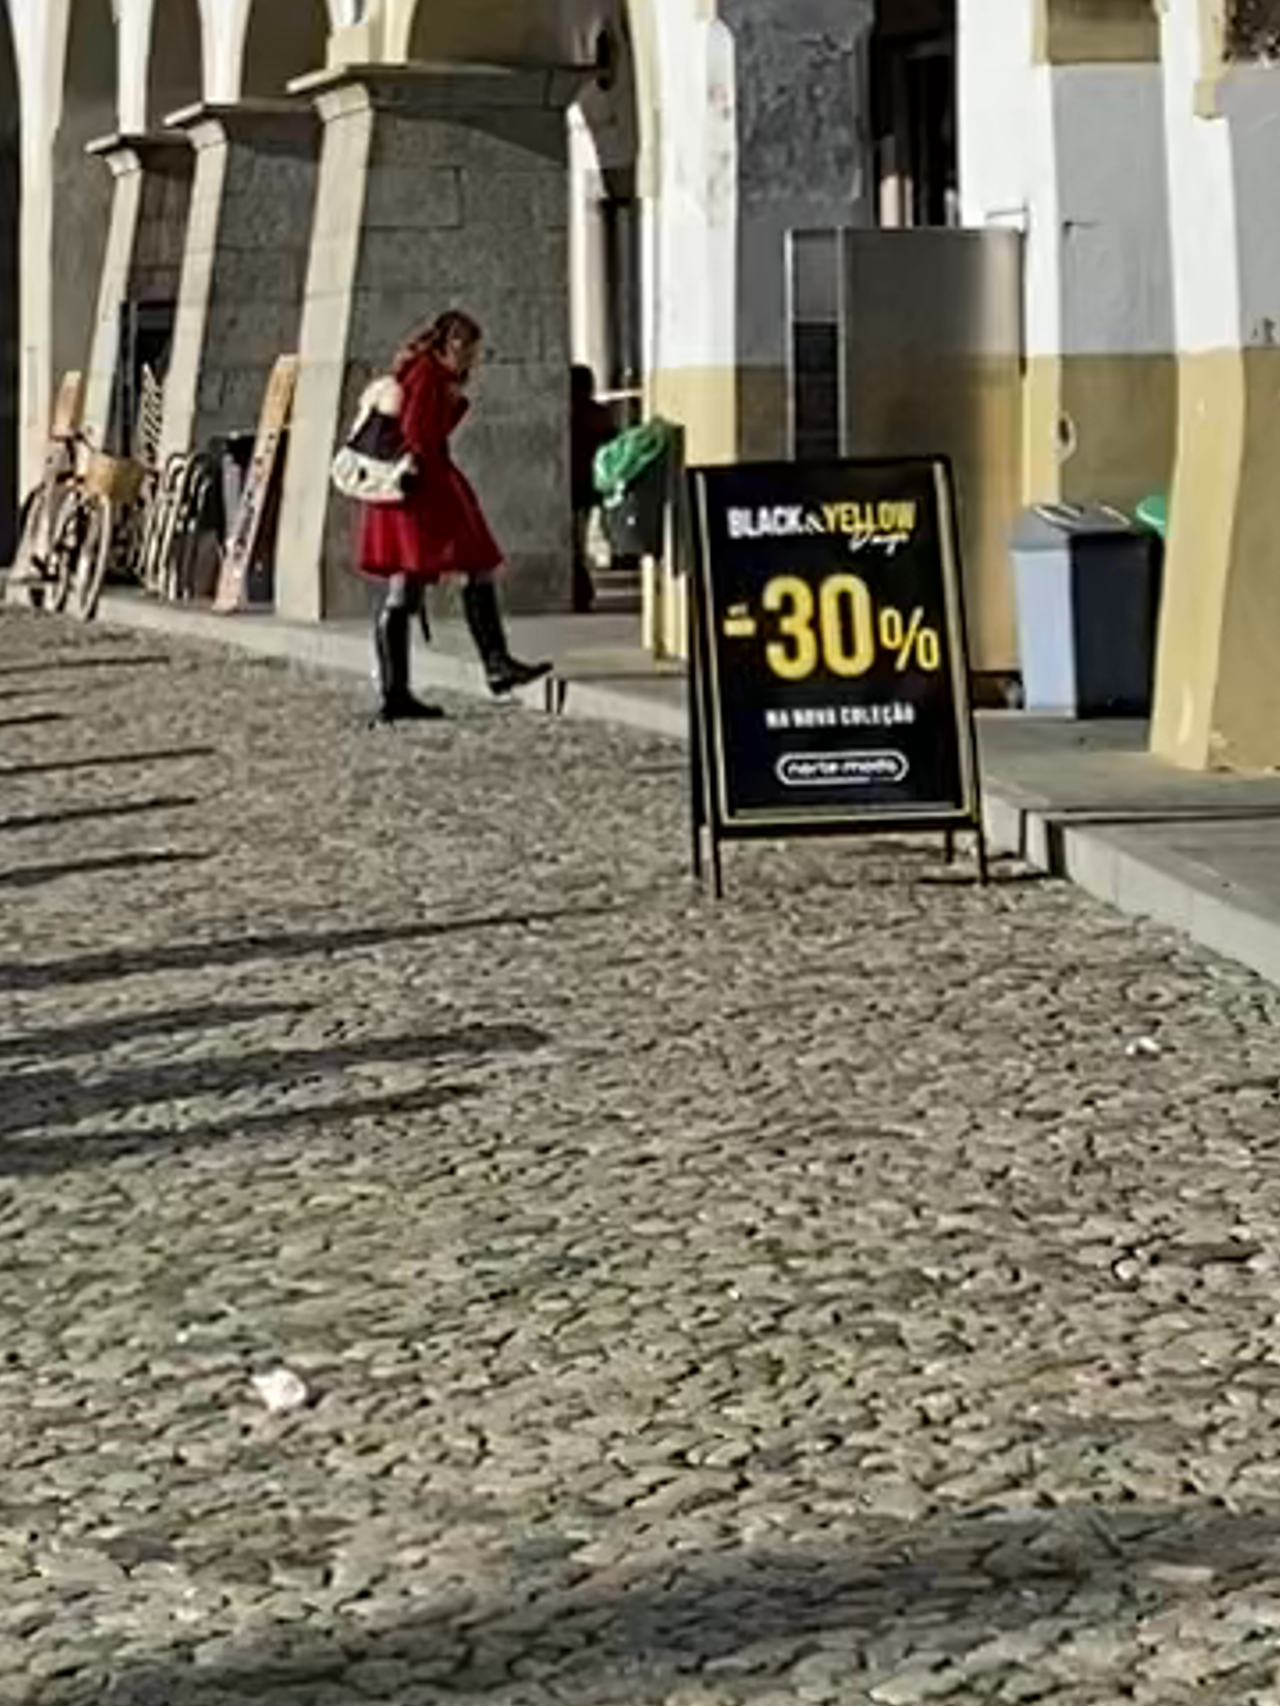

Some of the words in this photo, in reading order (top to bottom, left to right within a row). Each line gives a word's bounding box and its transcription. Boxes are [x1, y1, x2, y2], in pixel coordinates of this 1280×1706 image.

[765, 709, 790, 728] NA
[793, 708, 836, 728] NOVA
[840, 701, 915, 728] COLEÇÃO
